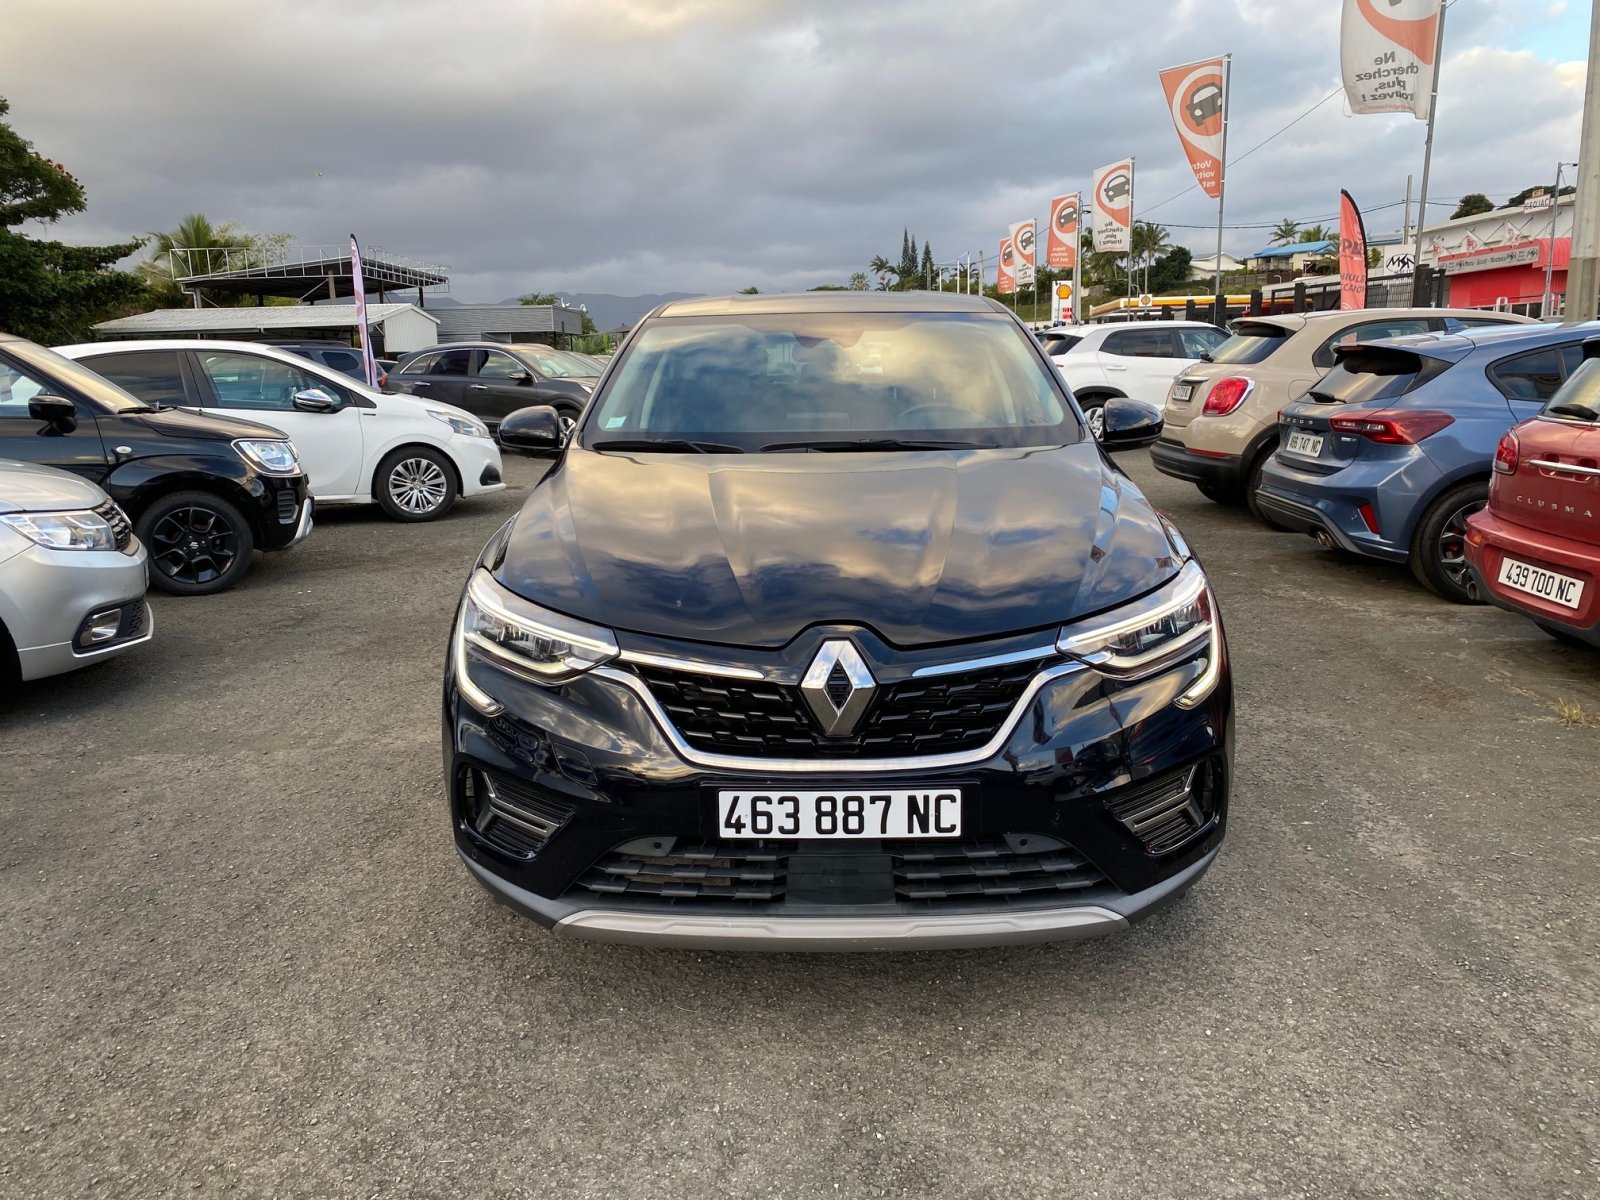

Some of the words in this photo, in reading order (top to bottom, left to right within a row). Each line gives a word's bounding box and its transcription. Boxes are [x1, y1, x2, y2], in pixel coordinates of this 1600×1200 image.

[1506, 563, 1529, 588] 439
[1531, 570, 1556, 596] 700
[1555, 578, 1576, 603] NC
[724, 795, 800, 835] 463
[815, 795, 892, 835] 887
[907, 794, 957, 835] NC
